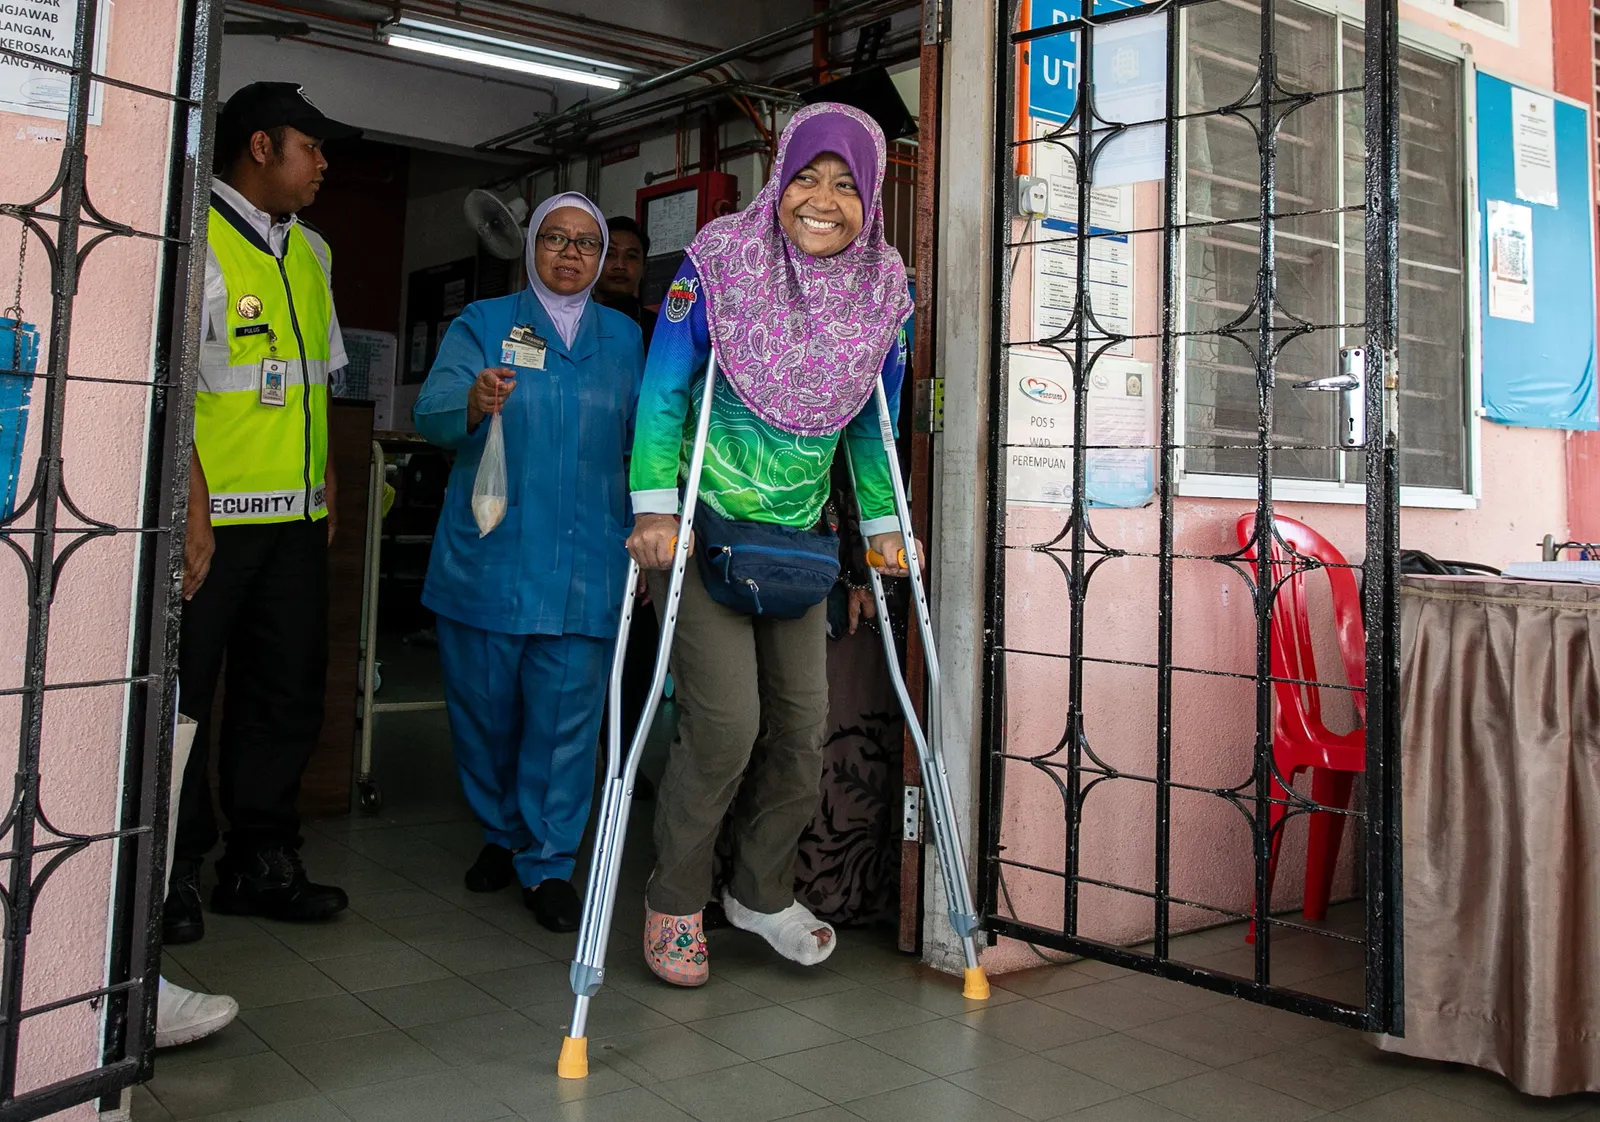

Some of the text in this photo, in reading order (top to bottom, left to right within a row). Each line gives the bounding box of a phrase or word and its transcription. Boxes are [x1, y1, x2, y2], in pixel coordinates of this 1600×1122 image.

[0, 37, 74, 60] KEROSAKAN
[1030, 415, 1055, 429] POS 5
[1029, 437, 1050, 447] WAD
[1012, 454, 1066, 469] PEREMPUAN
[210, 495, 295, 514] ECURITY
